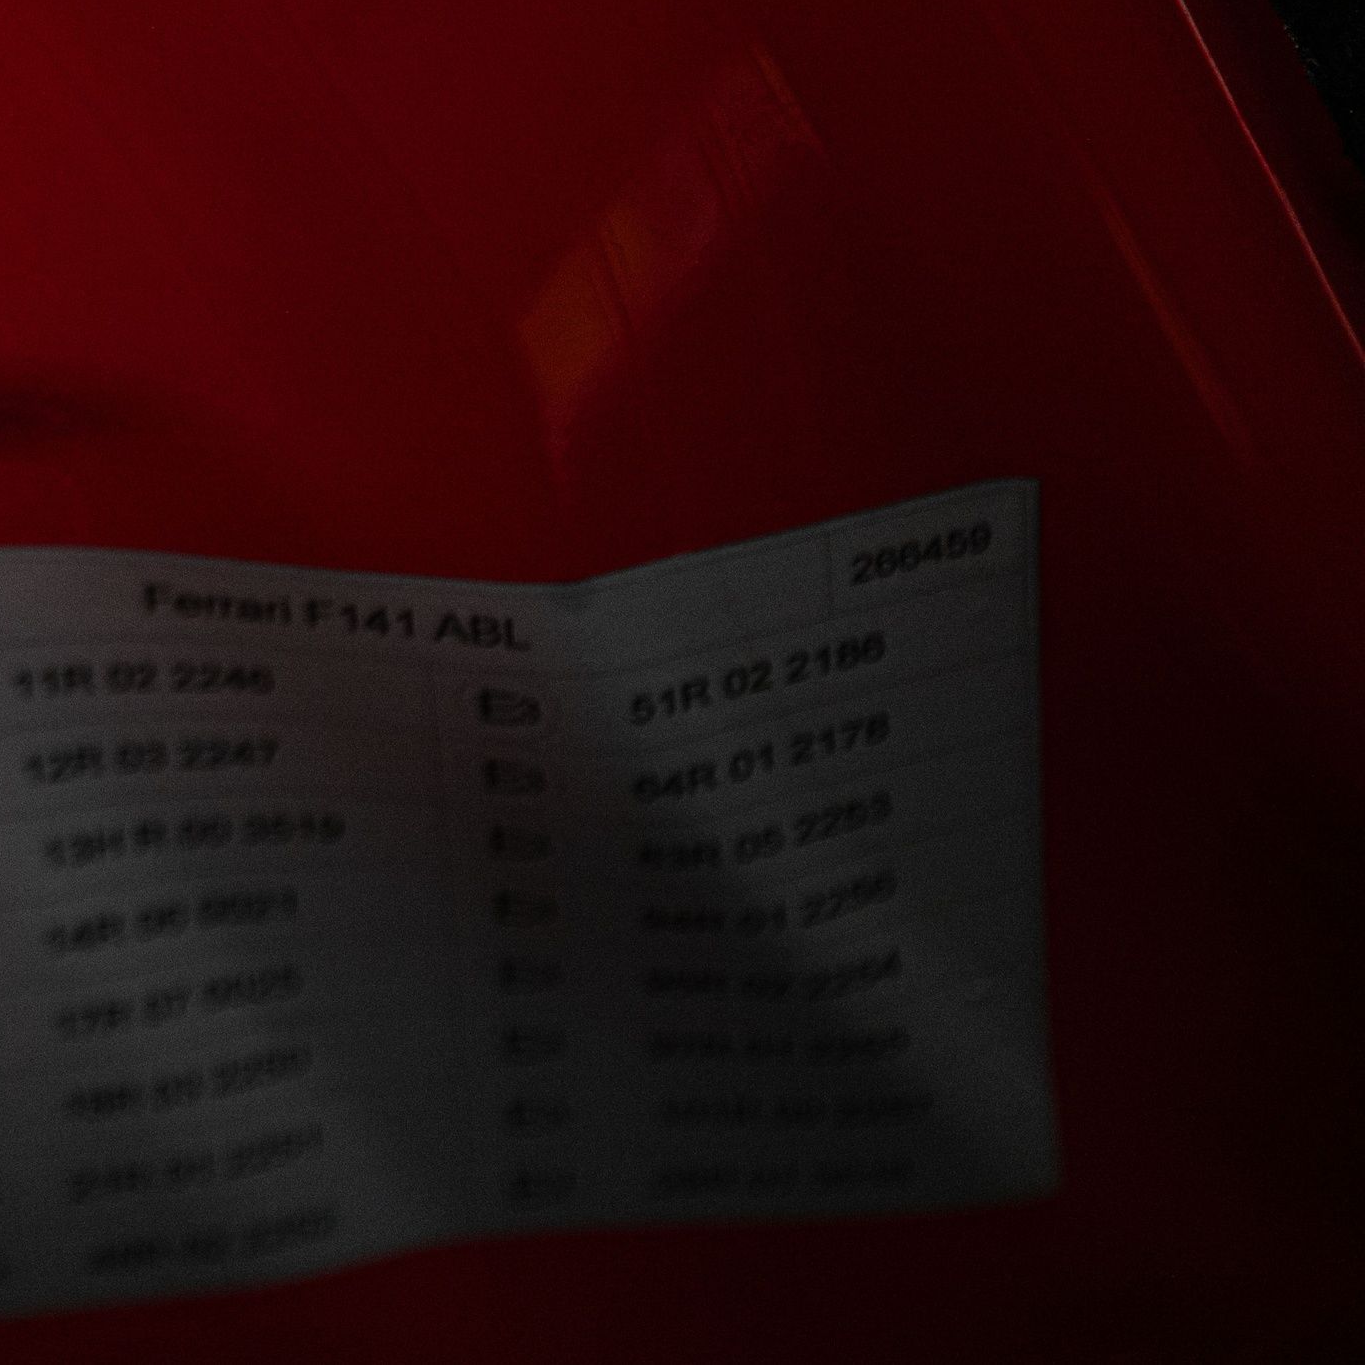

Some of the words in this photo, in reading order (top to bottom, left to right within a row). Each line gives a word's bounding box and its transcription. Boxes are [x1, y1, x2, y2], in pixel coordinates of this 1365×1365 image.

[143, 582, 292, 626] Ferrari
[303, 598, 416, 640] F141
[433, 613, 531, 652] ABL
[722, 658, 773, 699] 02
